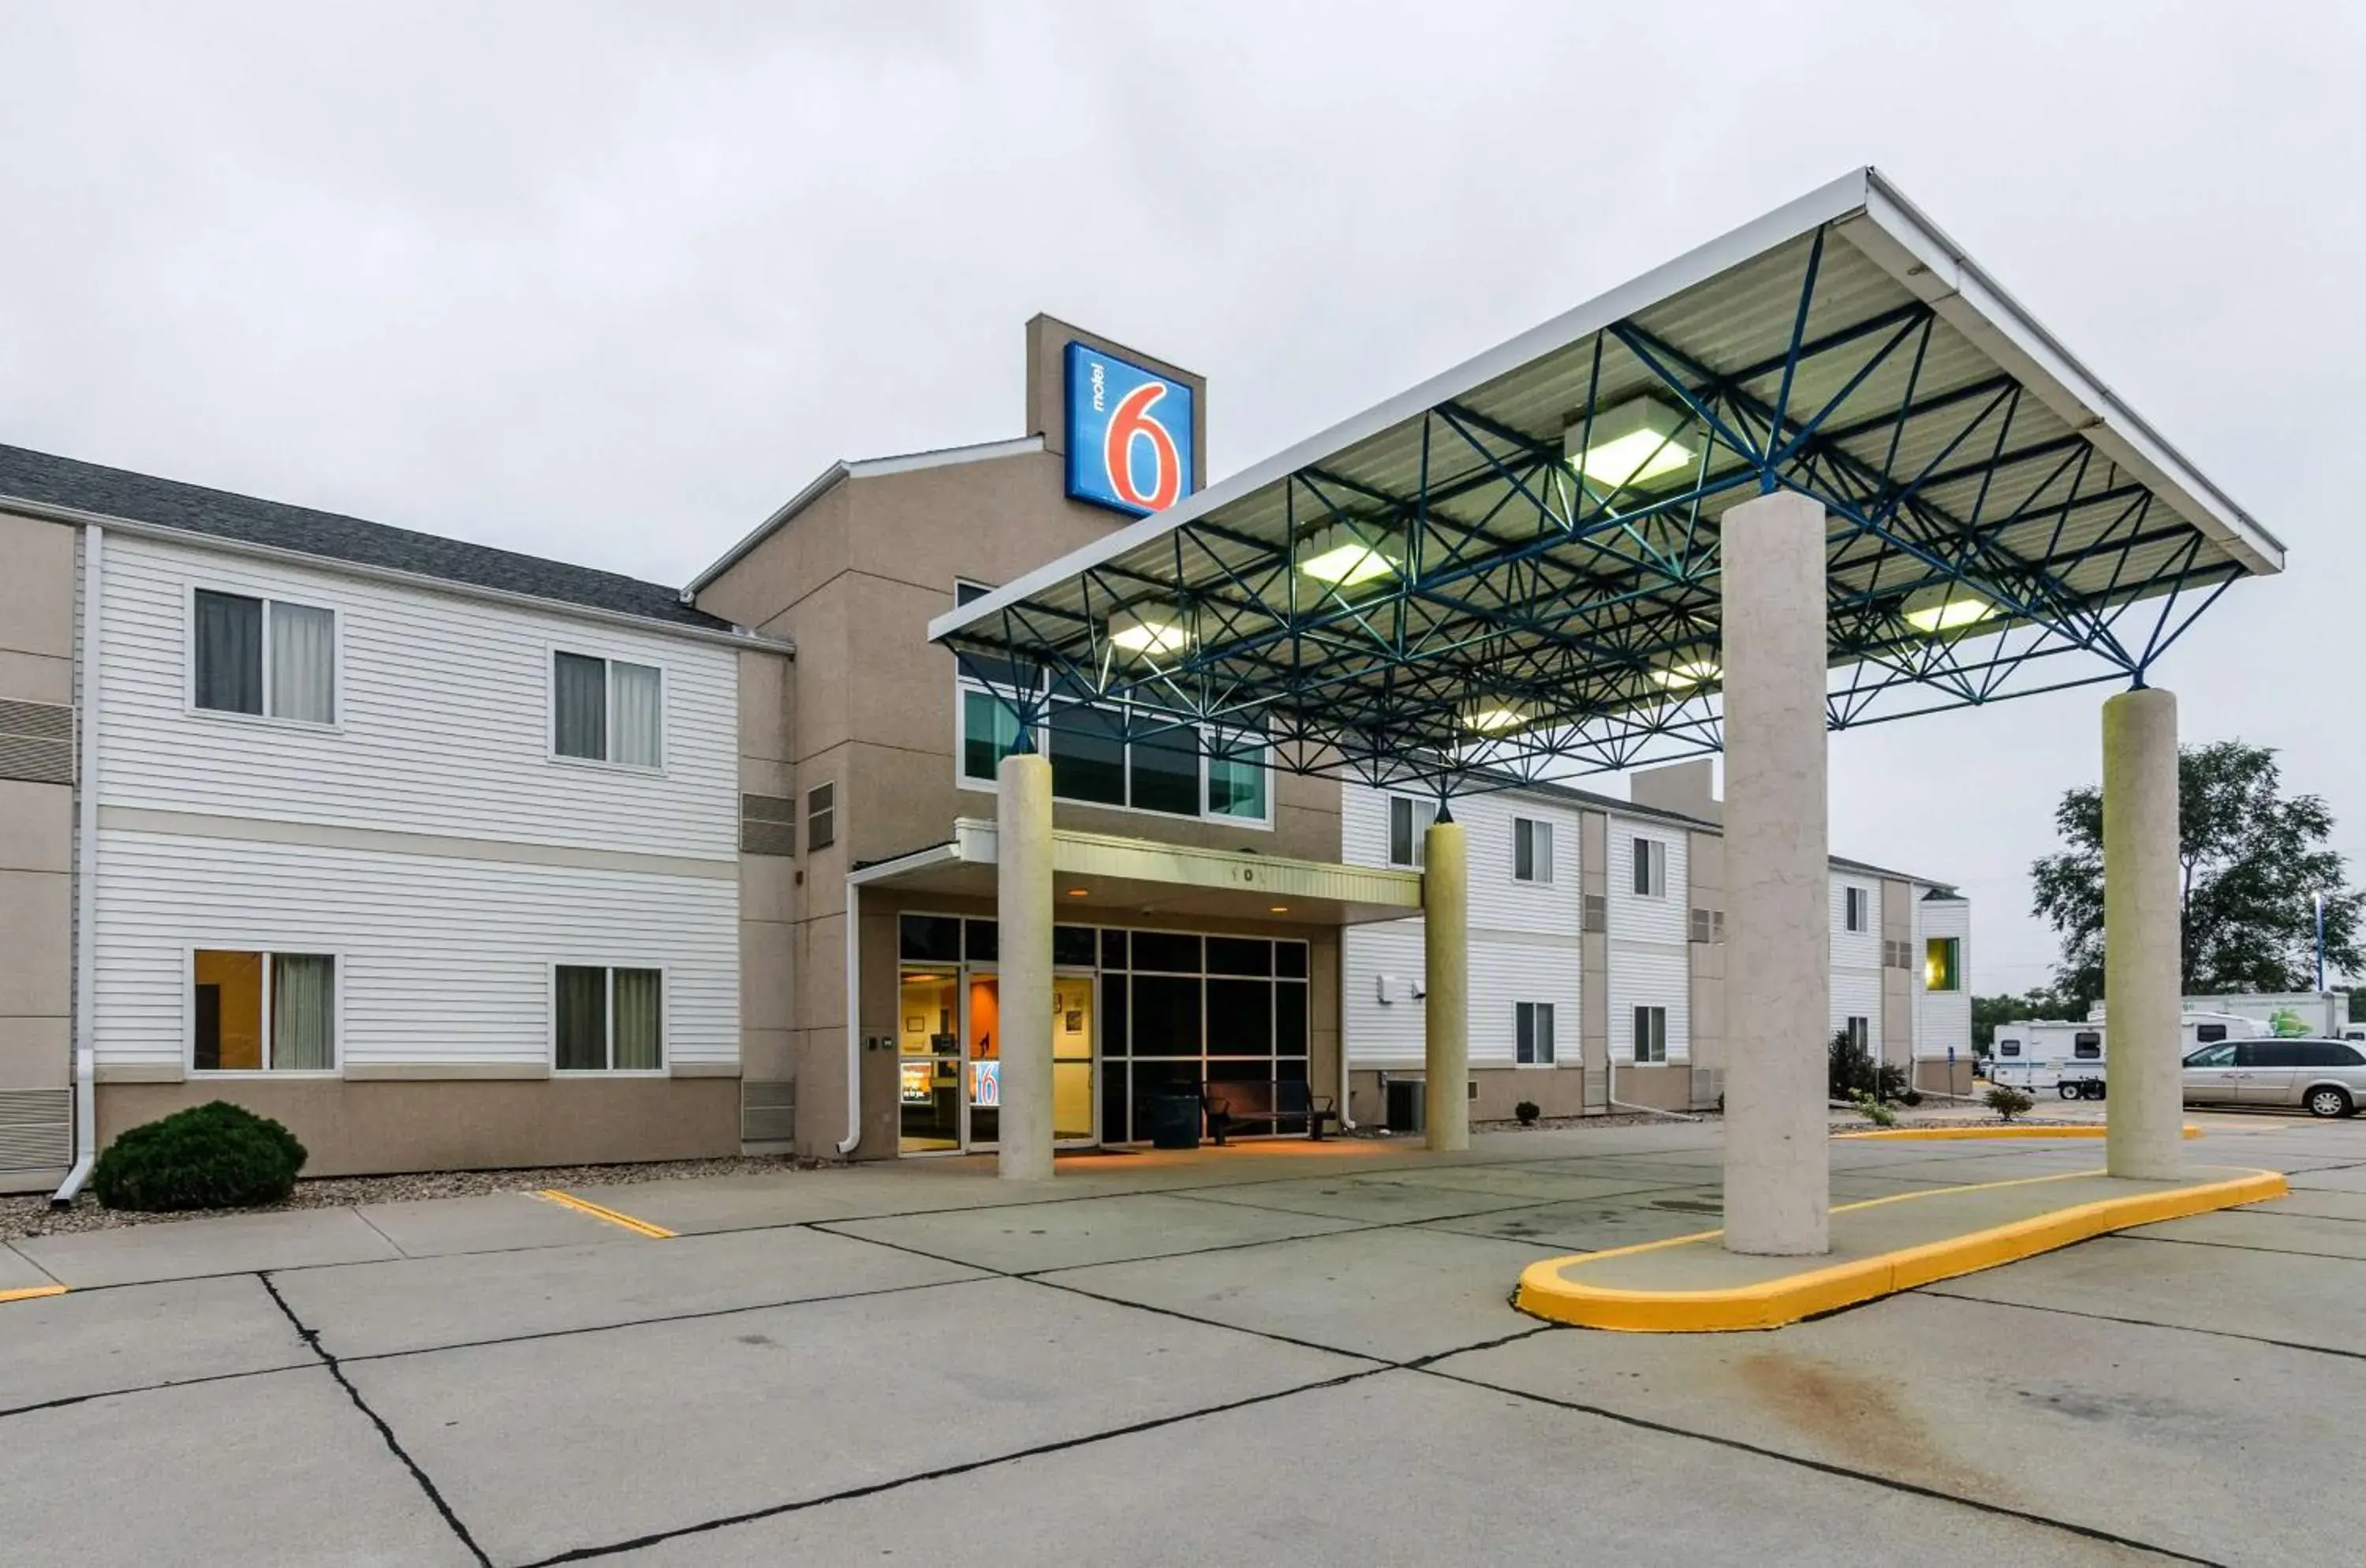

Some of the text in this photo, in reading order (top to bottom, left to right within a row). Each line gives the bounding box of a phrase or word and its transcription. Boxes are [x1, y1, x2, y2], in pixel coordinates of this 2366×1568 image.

[1092, 363, 1181, 511] motel 6
[980, 1062, 998, 1104] 6
